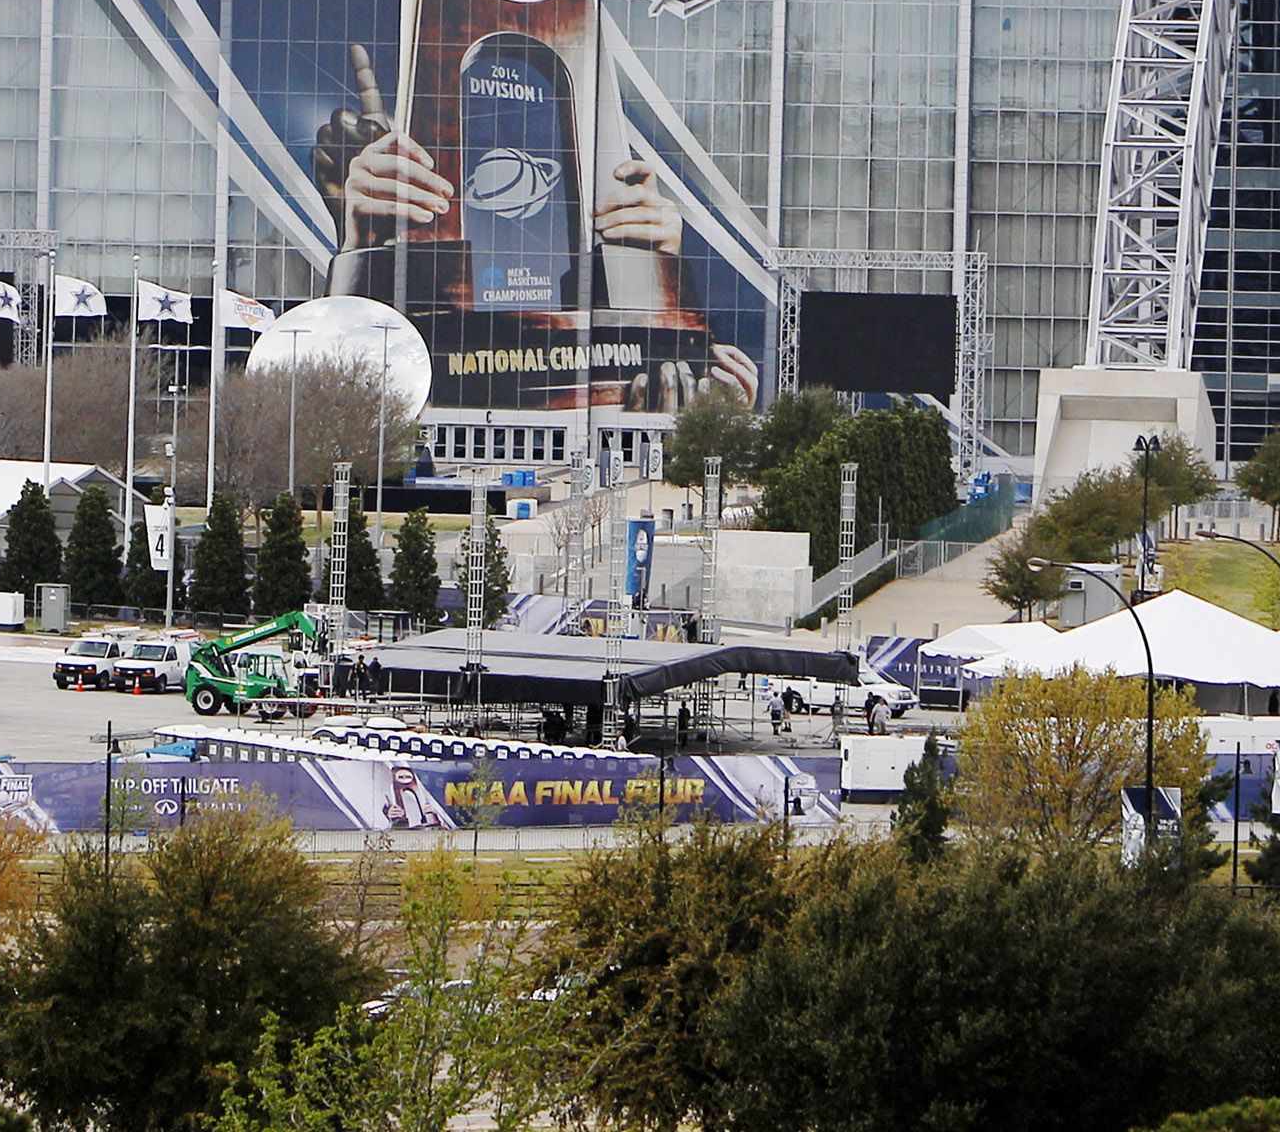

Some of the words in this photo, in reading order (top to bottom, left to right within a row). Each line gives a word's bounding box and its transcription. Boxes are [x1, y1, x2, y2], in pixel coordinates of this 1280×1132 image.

[491, 65, 520, 81] 2014
[470, 76, 535, 103] DIVISION
[538, 87, 544, 103] I
[507, 266, 531, 277] MEN'S
[507, 276, 552, 287] BASKETBALL
[483, 289, 553, 302] CHAMPIONSHIP
[448, 348, 548, 376] NATIONAL
[549, 343, 642, 370] CHAMPION
[486, 410, 492, 423] C
[155, 533, 165, 558] 4
[169, 778, 239, 794] TAILGATE
[444, 779, 529, 806] NCAA
[535, 779, 619, 806] FINAL
[624, 778, 707, 805] FOUR
